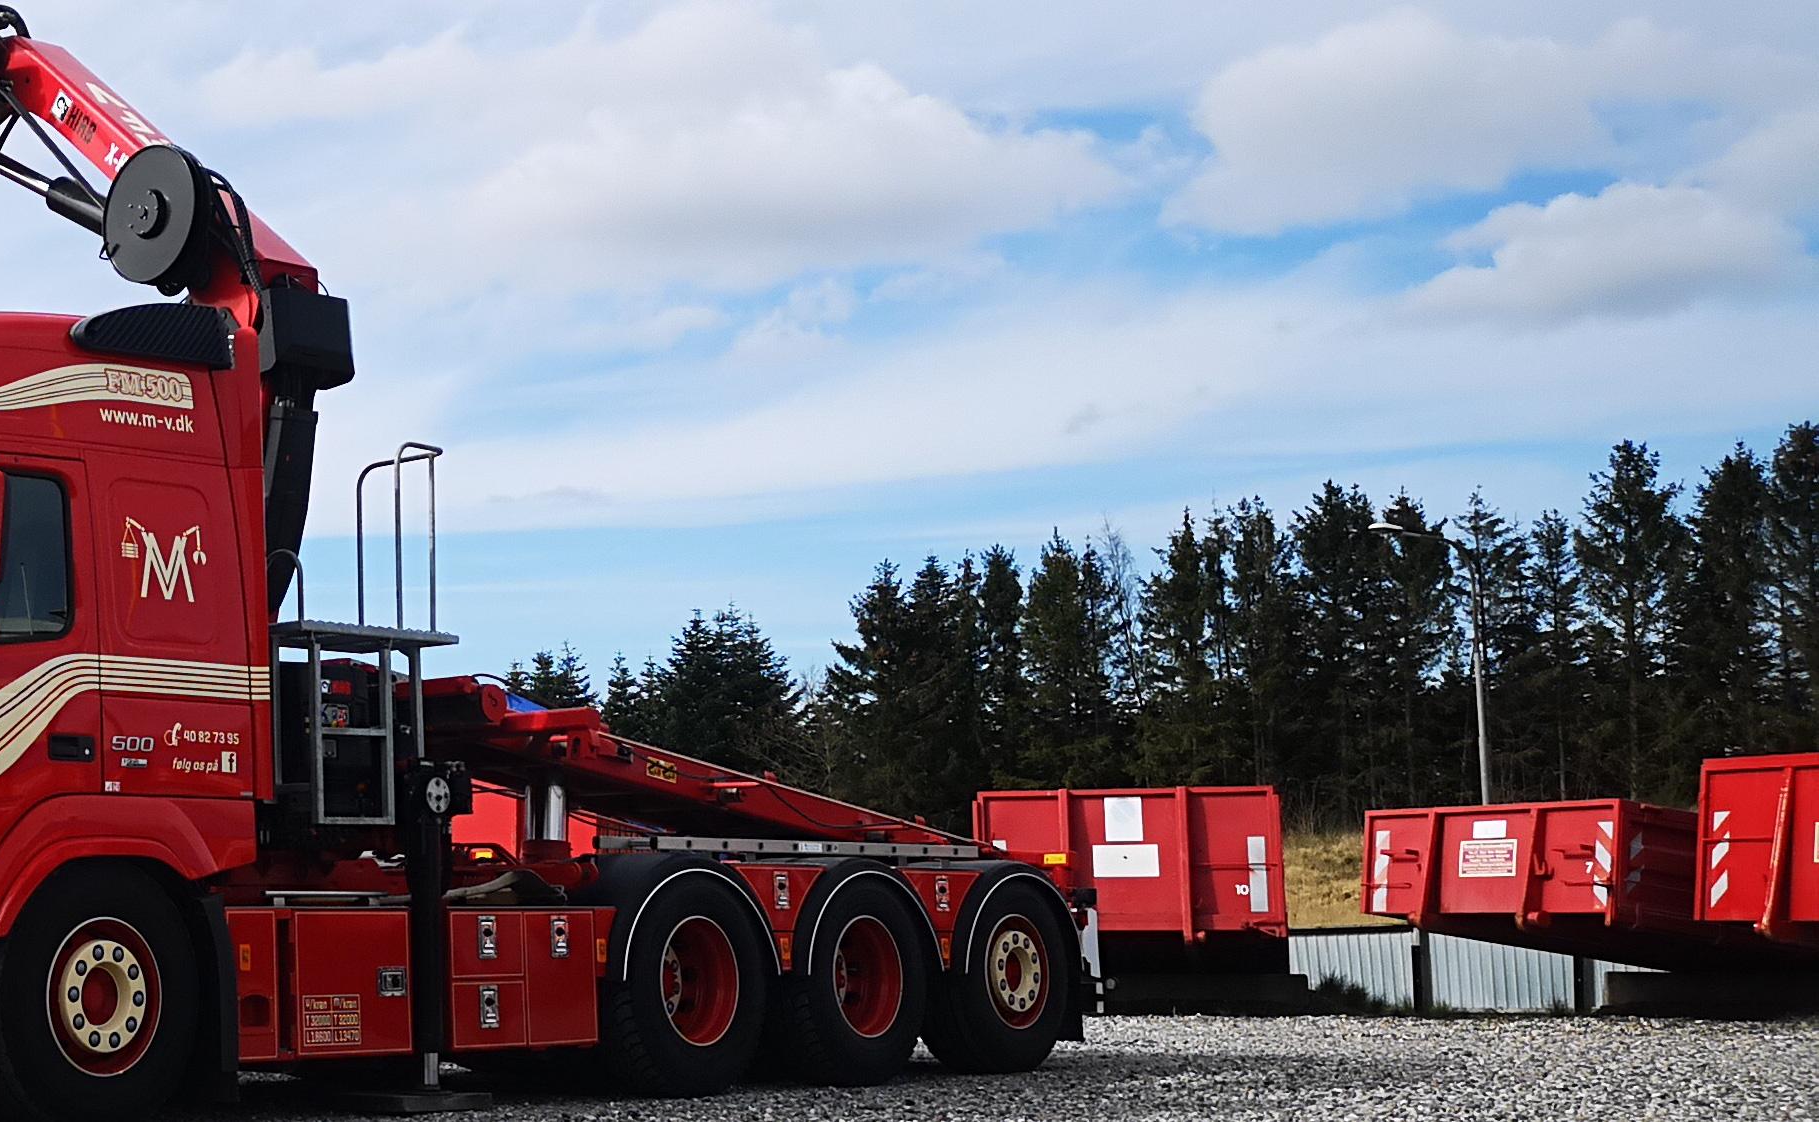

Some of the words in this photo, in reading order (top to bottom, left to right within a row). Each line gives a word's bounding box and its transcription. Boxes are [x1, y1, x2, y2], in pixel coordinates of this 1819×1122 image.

[100, 408, 194, 433] www.m-v.dk
[112, 735, 154, 752] 500
[184, 729, 197, 742] 40
[198, 730, 211, 743] 82
[213, 731, 225, 744] 73
[227, 732, 240, 745] 95
[172, 756, 192, 773] følg
[193, 761, 205, 771] os
[207, 759, 219, 774] på
[1585, 861, 1594, 874] 7
[1235, 884, 1249, 896] 10
